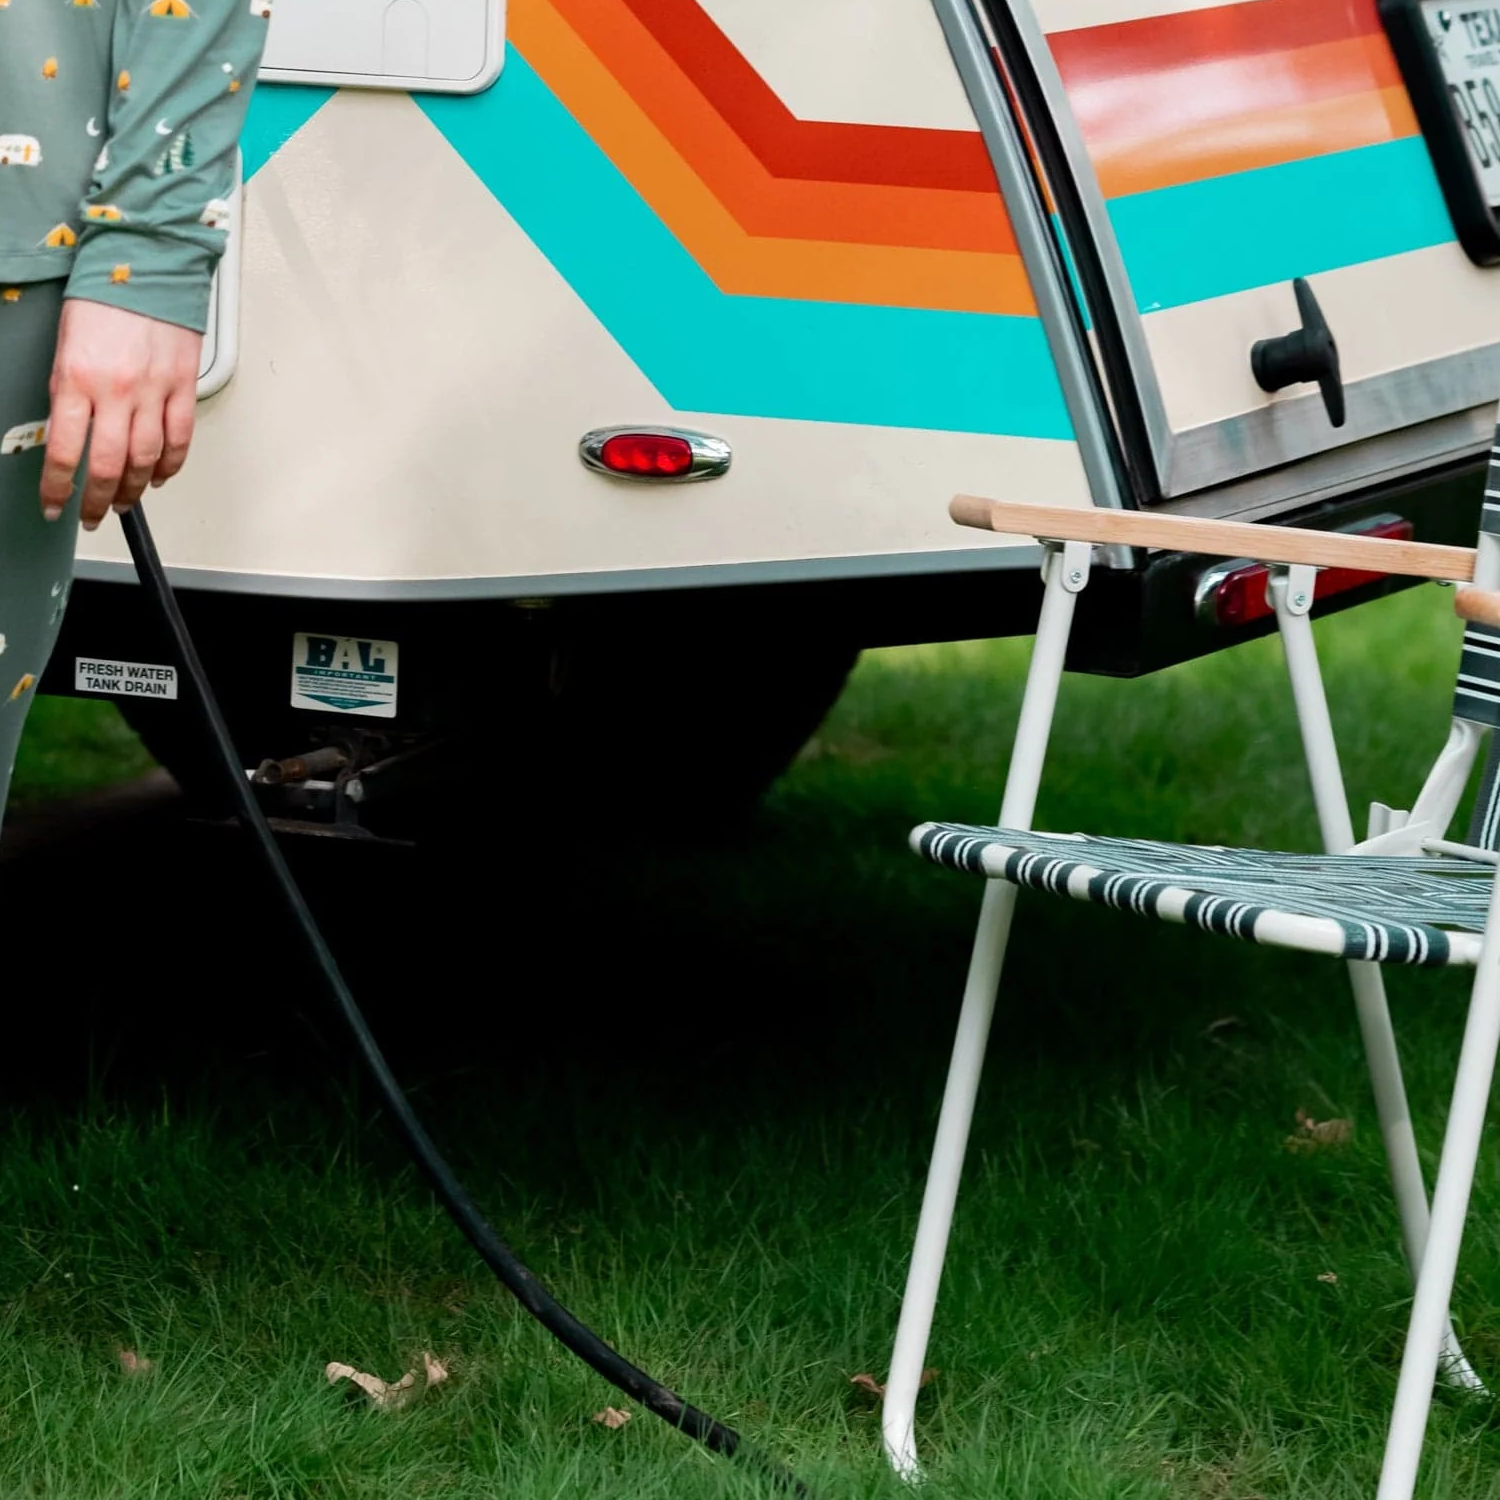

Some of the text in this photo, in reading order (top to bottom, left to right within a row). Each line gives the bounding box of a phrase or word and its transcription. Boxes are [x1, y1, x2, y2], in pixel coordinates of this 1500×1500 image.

[80, 662, 173, 681] FRESH WATER
[86, 677, 167, 695] TANK DRAIN
